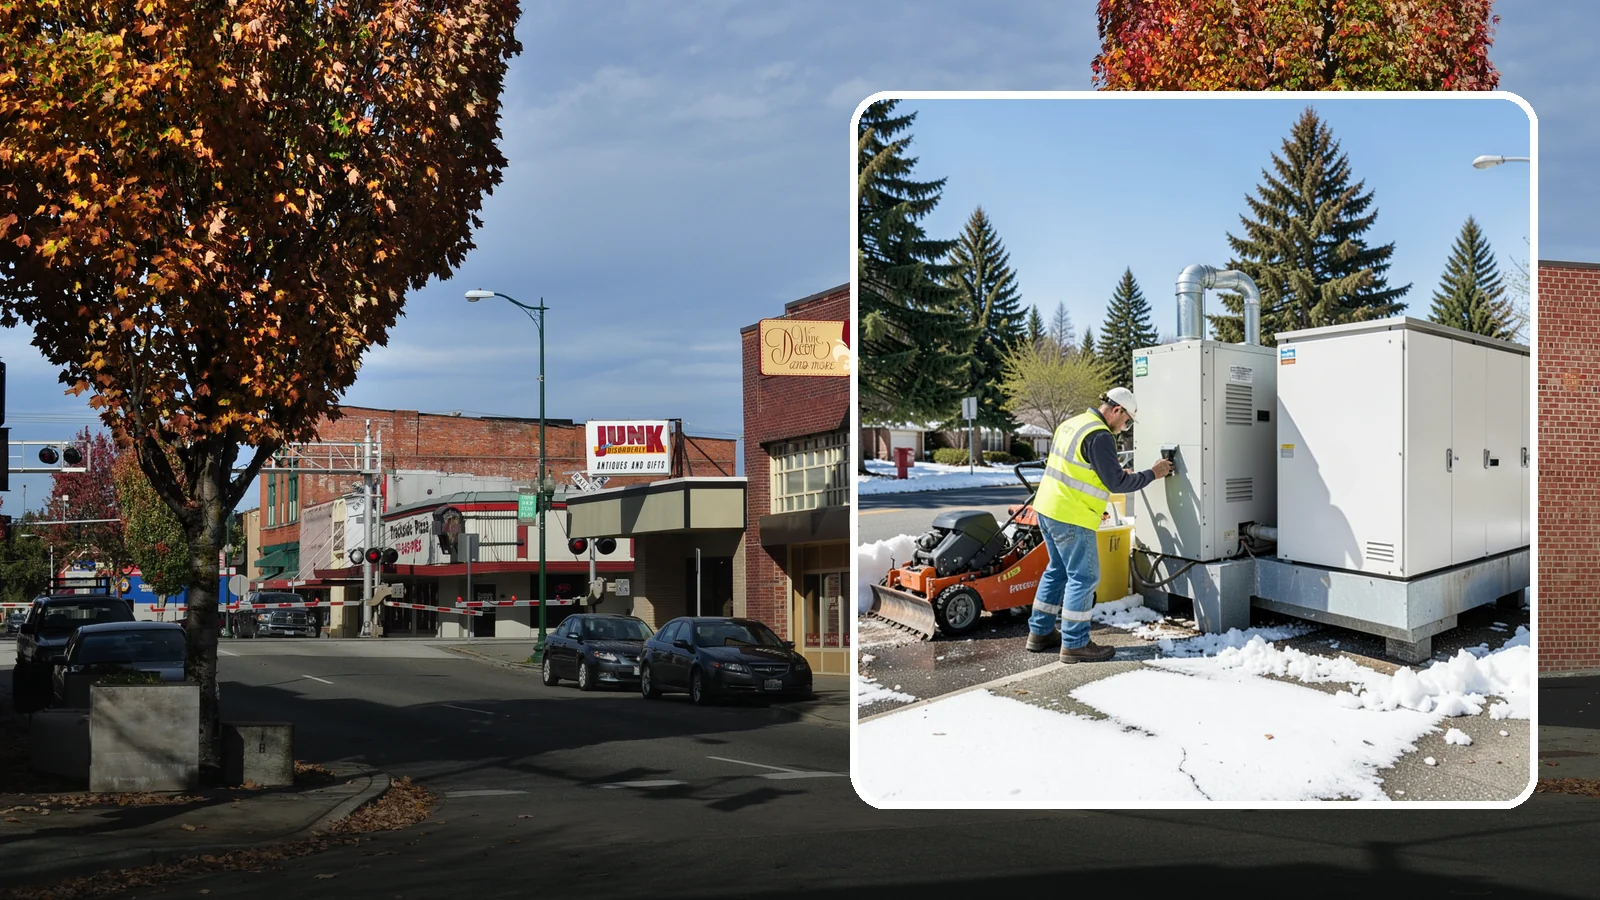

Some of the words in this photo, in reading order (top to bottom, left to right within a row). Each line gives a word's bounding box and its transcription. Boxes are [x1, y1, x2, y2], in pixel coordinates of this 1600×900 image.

[765, 327, 831, 365] Decor
[595, 425, 665, 457] JUNK
[607, 446, 646, 454] DISORDERLY
[596, 461, 628, 470] ANTIQUES
[631, 461, 644, 470] AND
[647, 460, 665, 470] GIFTS
[352, 498, 365, 511] CRO
[390, 521, 413, 539] Trackside
[414, 519, 429, 535] Pizza
